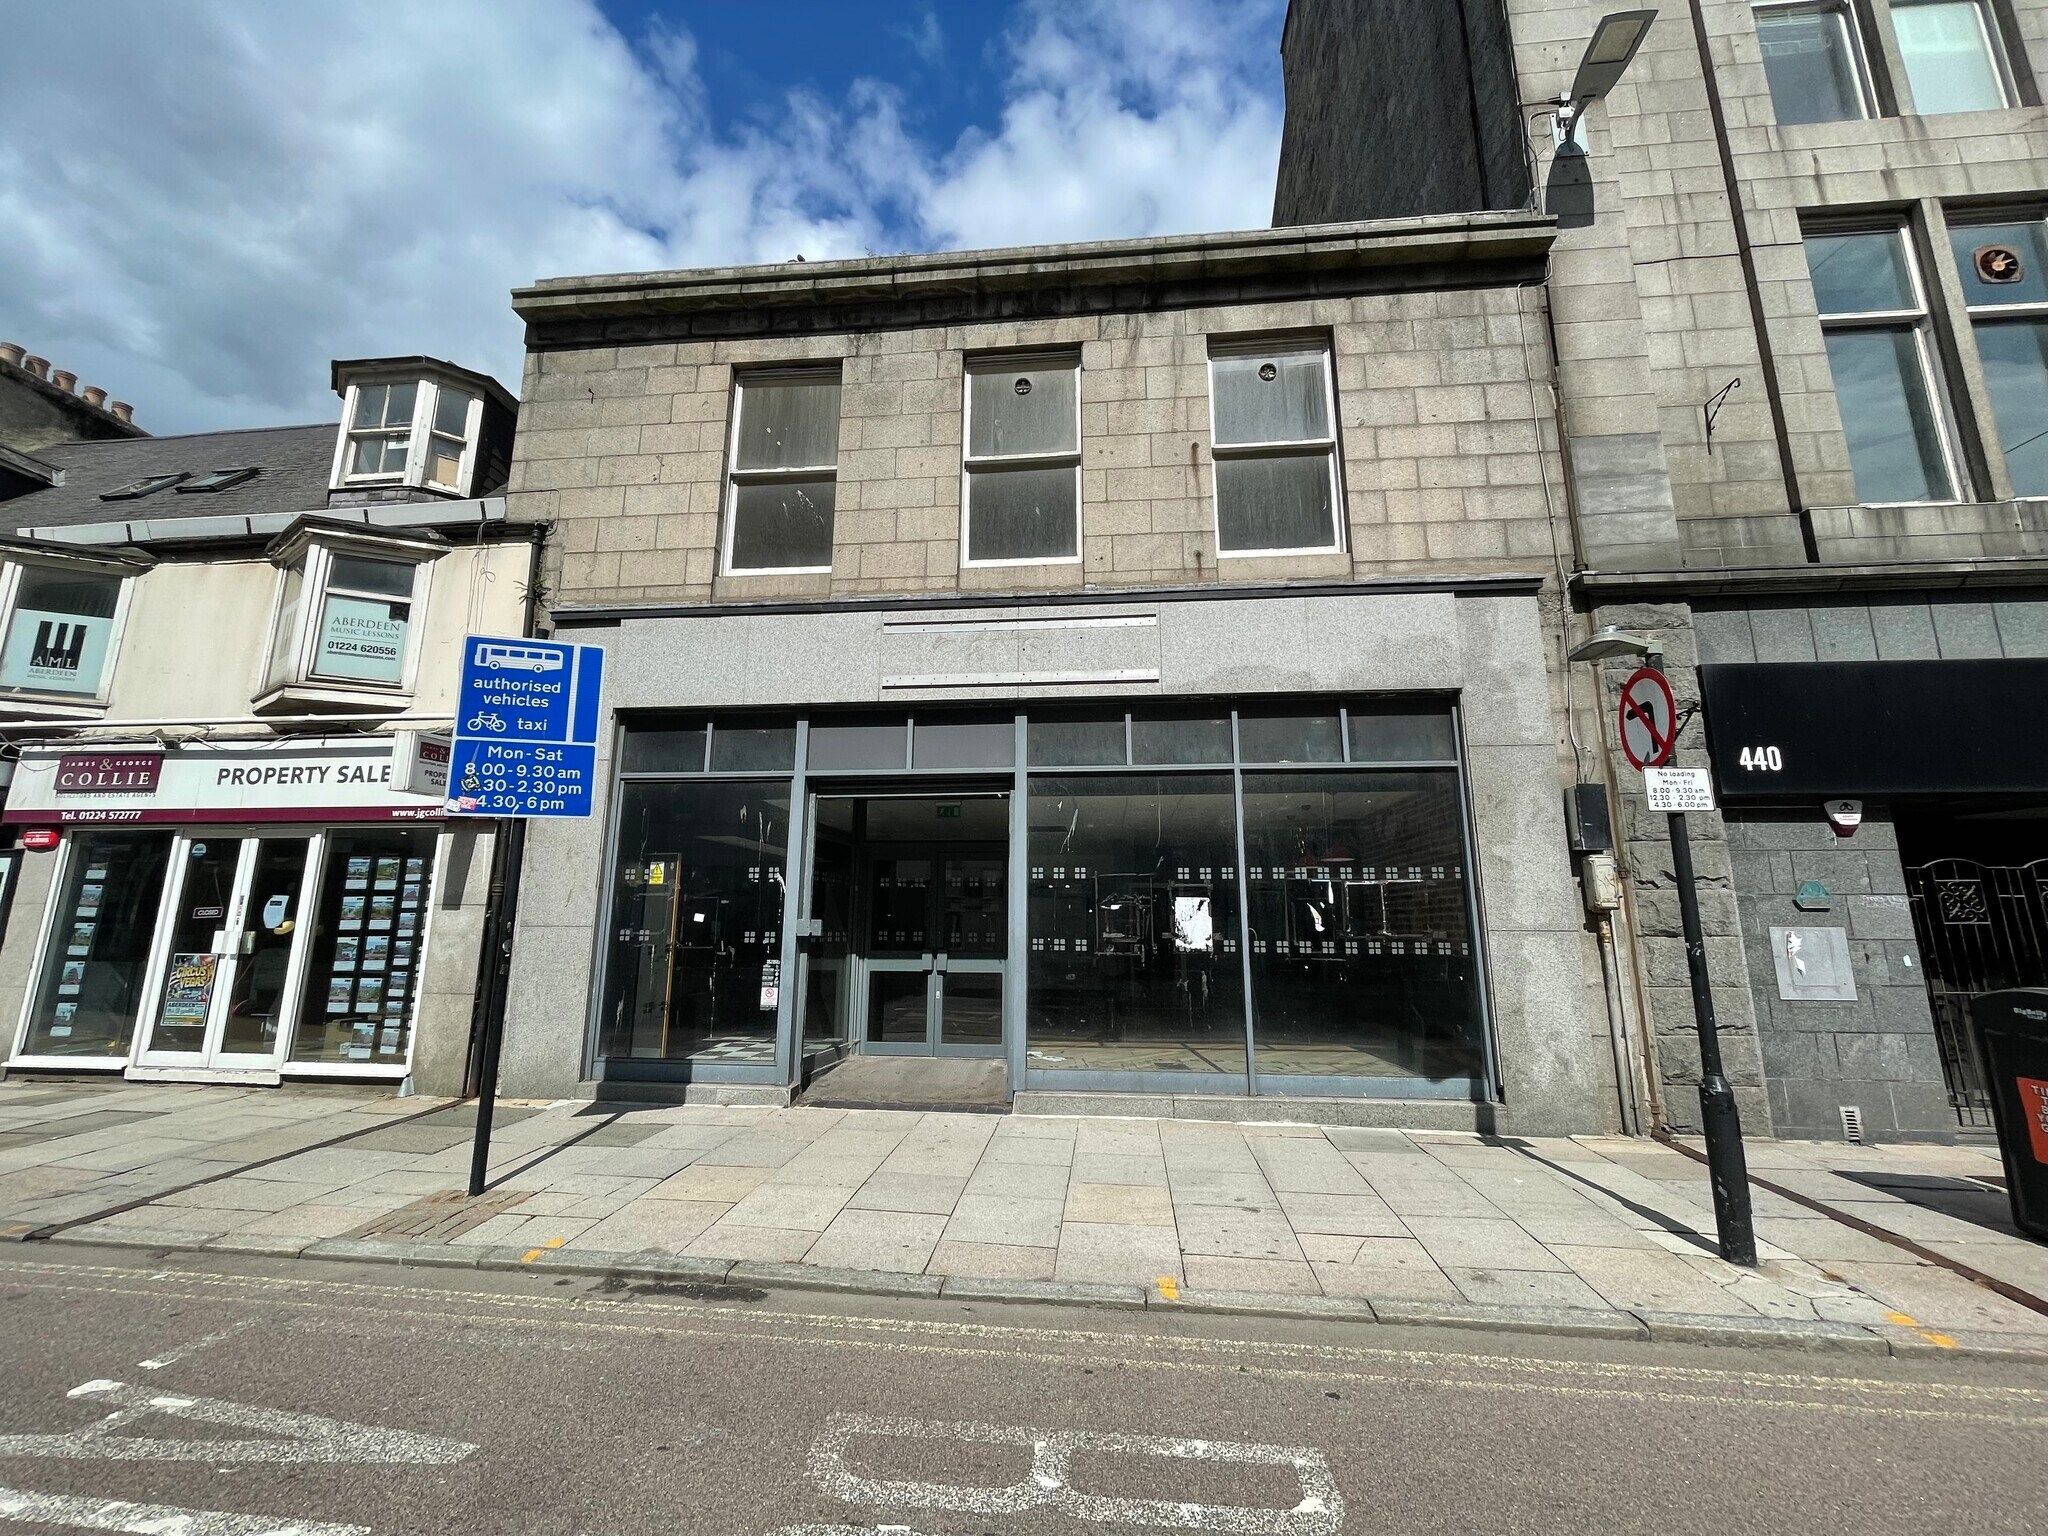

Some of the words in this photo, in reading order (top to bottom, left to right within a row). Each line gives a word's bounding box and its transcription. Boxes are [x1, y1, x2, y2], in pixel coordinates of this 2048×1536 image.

[332, 616, 400, 632] ABERDEEN
[330, 626, 360, 636] MUSIC
[362, 629, 399, 640] LESSONS
[328, 641, 357, 651] 01224
[360, 644, 397, 655] 620556
[33, 656, 76, 668] AML
[29, 667, 77, 677] ABERDEEN
[473, 678, 561, 694] authorised
[483, 694, 549, 708] vehicles
[517, 718, 548, 731] taxi
[99, 758, 113, 771] &
[1740, 746, 1782, 771] 440
[61, 772, 151, 786] COLLIE
[216, 765, 331, 785] PROPERTY
[424, 770, 447, 779] PROPE
[557, 768, 581, 779] am
[1669, 770, 1695, 778] loading
[558, 784, 582, 797] pm
[61, 811, 77, 820] Tel.
[79, 811, 106, 820] 01224
[108, 811, 142, 820] 572777
[392, 808, 445, 819] www.jgcolli
[176, 965, 207, 979] CIRCUS
[179, 976, 206, 989] VEGAS
